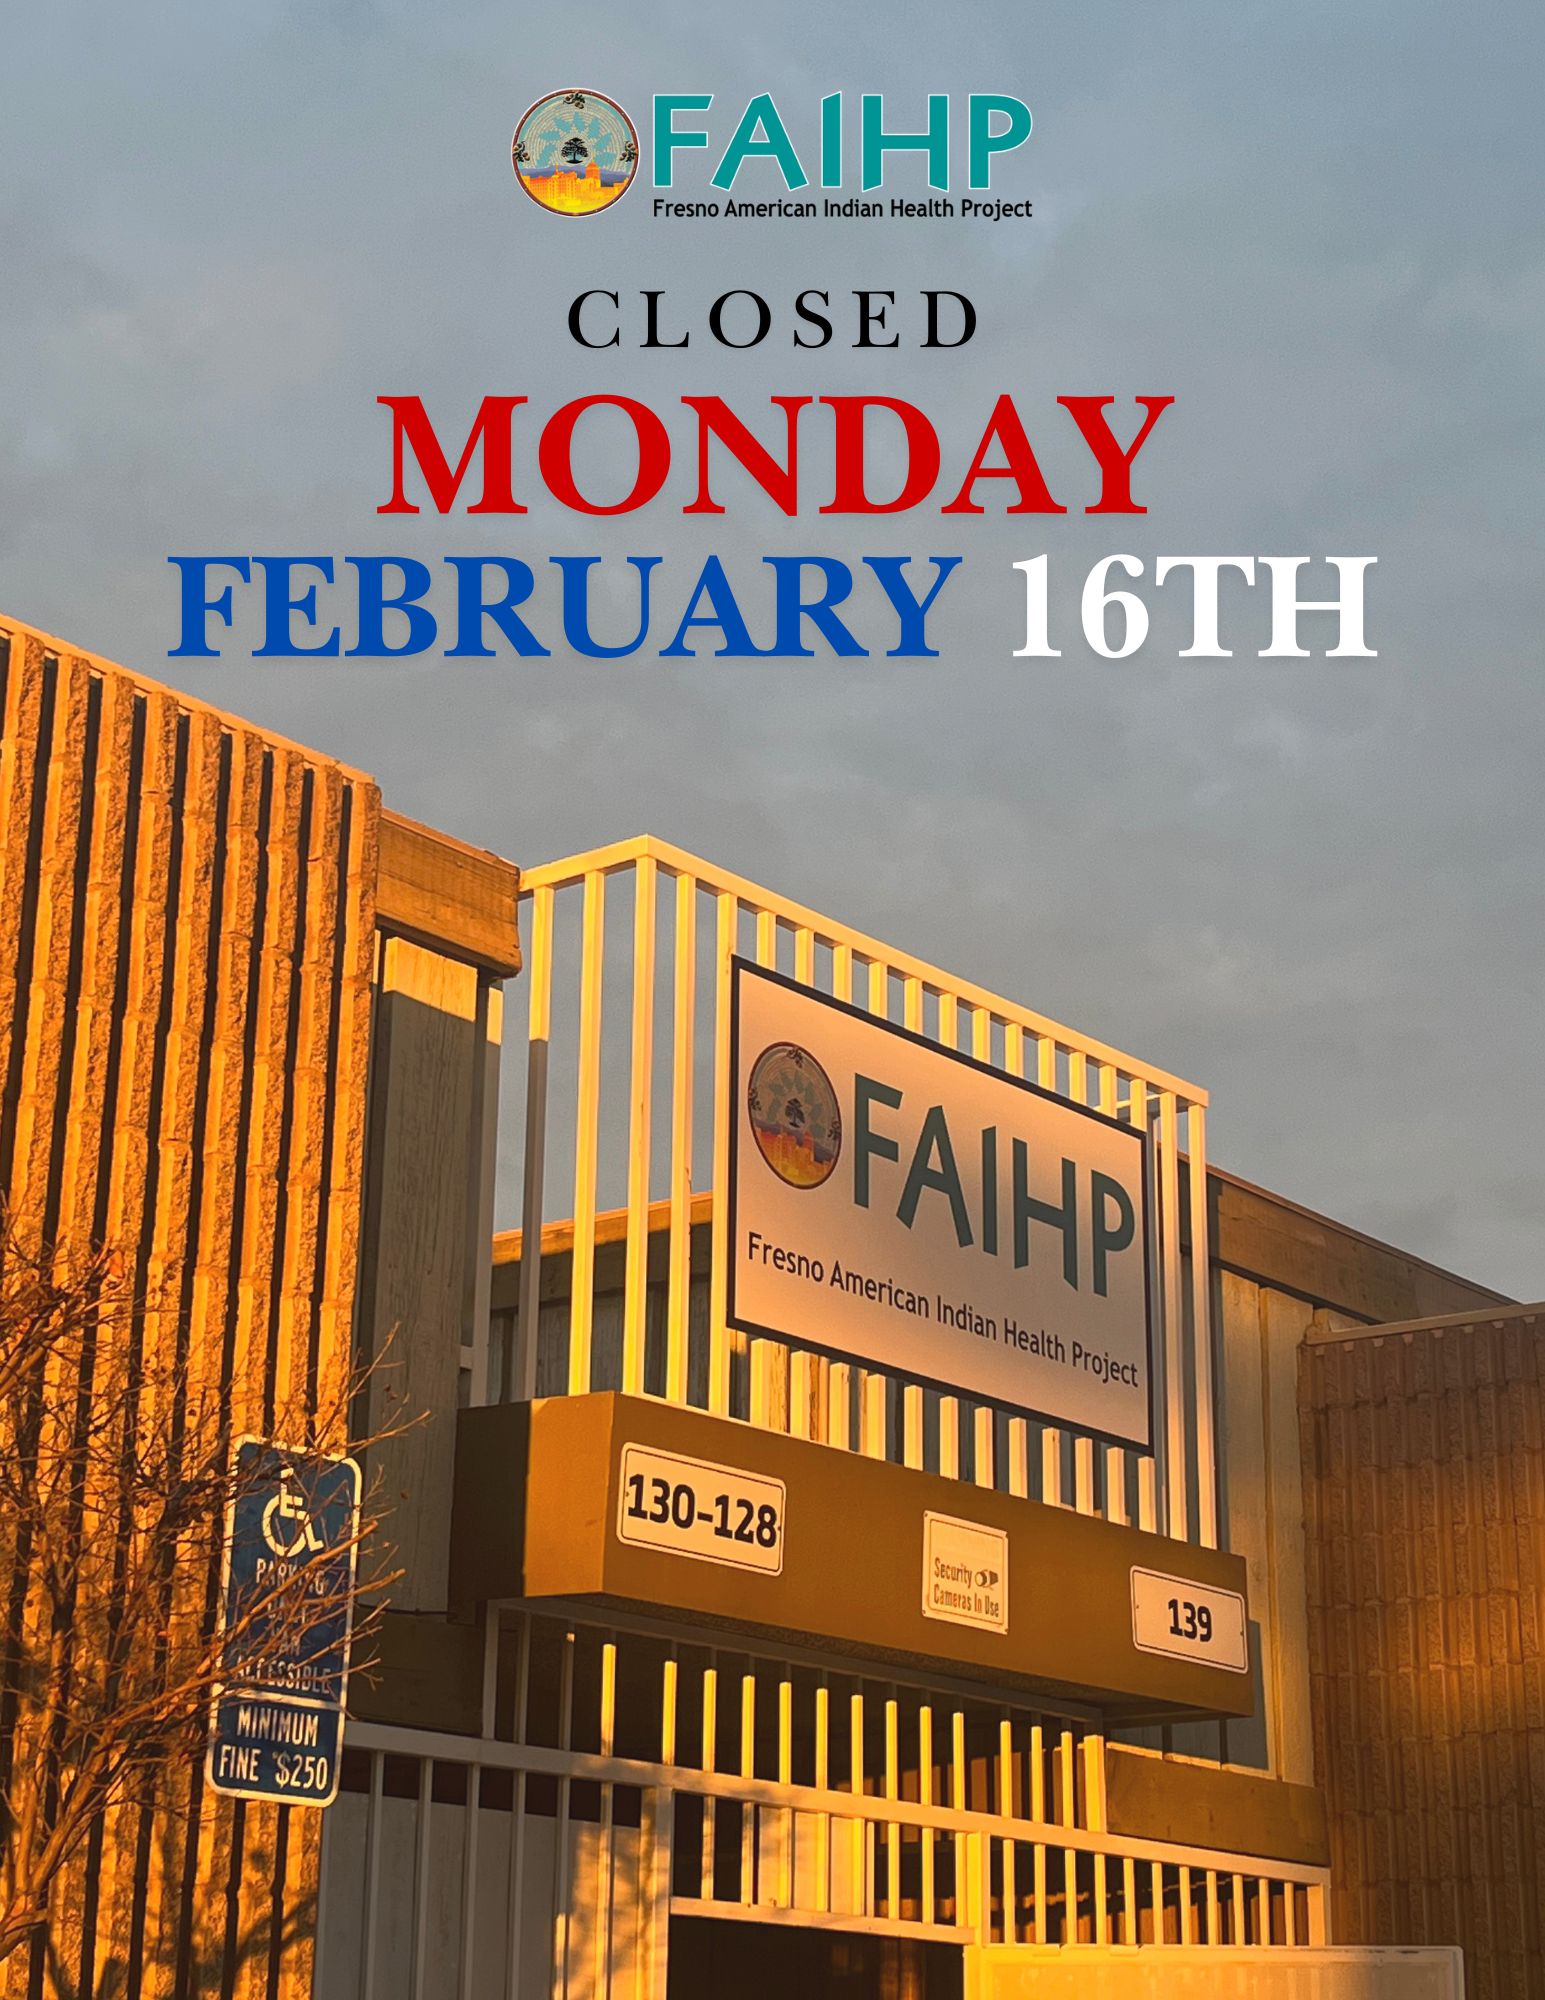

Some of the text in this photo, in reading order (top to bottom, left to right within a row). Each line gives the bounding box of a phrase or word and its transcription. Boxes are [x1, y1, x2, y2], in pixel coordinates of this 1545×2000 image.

[854, 1073, 1135, 1298] FAIHP
[748, 1232, 1138, 1388] Fresno American Indian Health Project
[628, 1473, 777, 1548] 130-128
[934, 1557, 972, 1588] Security
[934, 1584, 999, 1617] Cameras In Use
[1168, 1599, 1212, 1642] 139
[237, 1705, 319, 1747] MINIMUM
[219, 1744, 328, 1790] FINE $250
